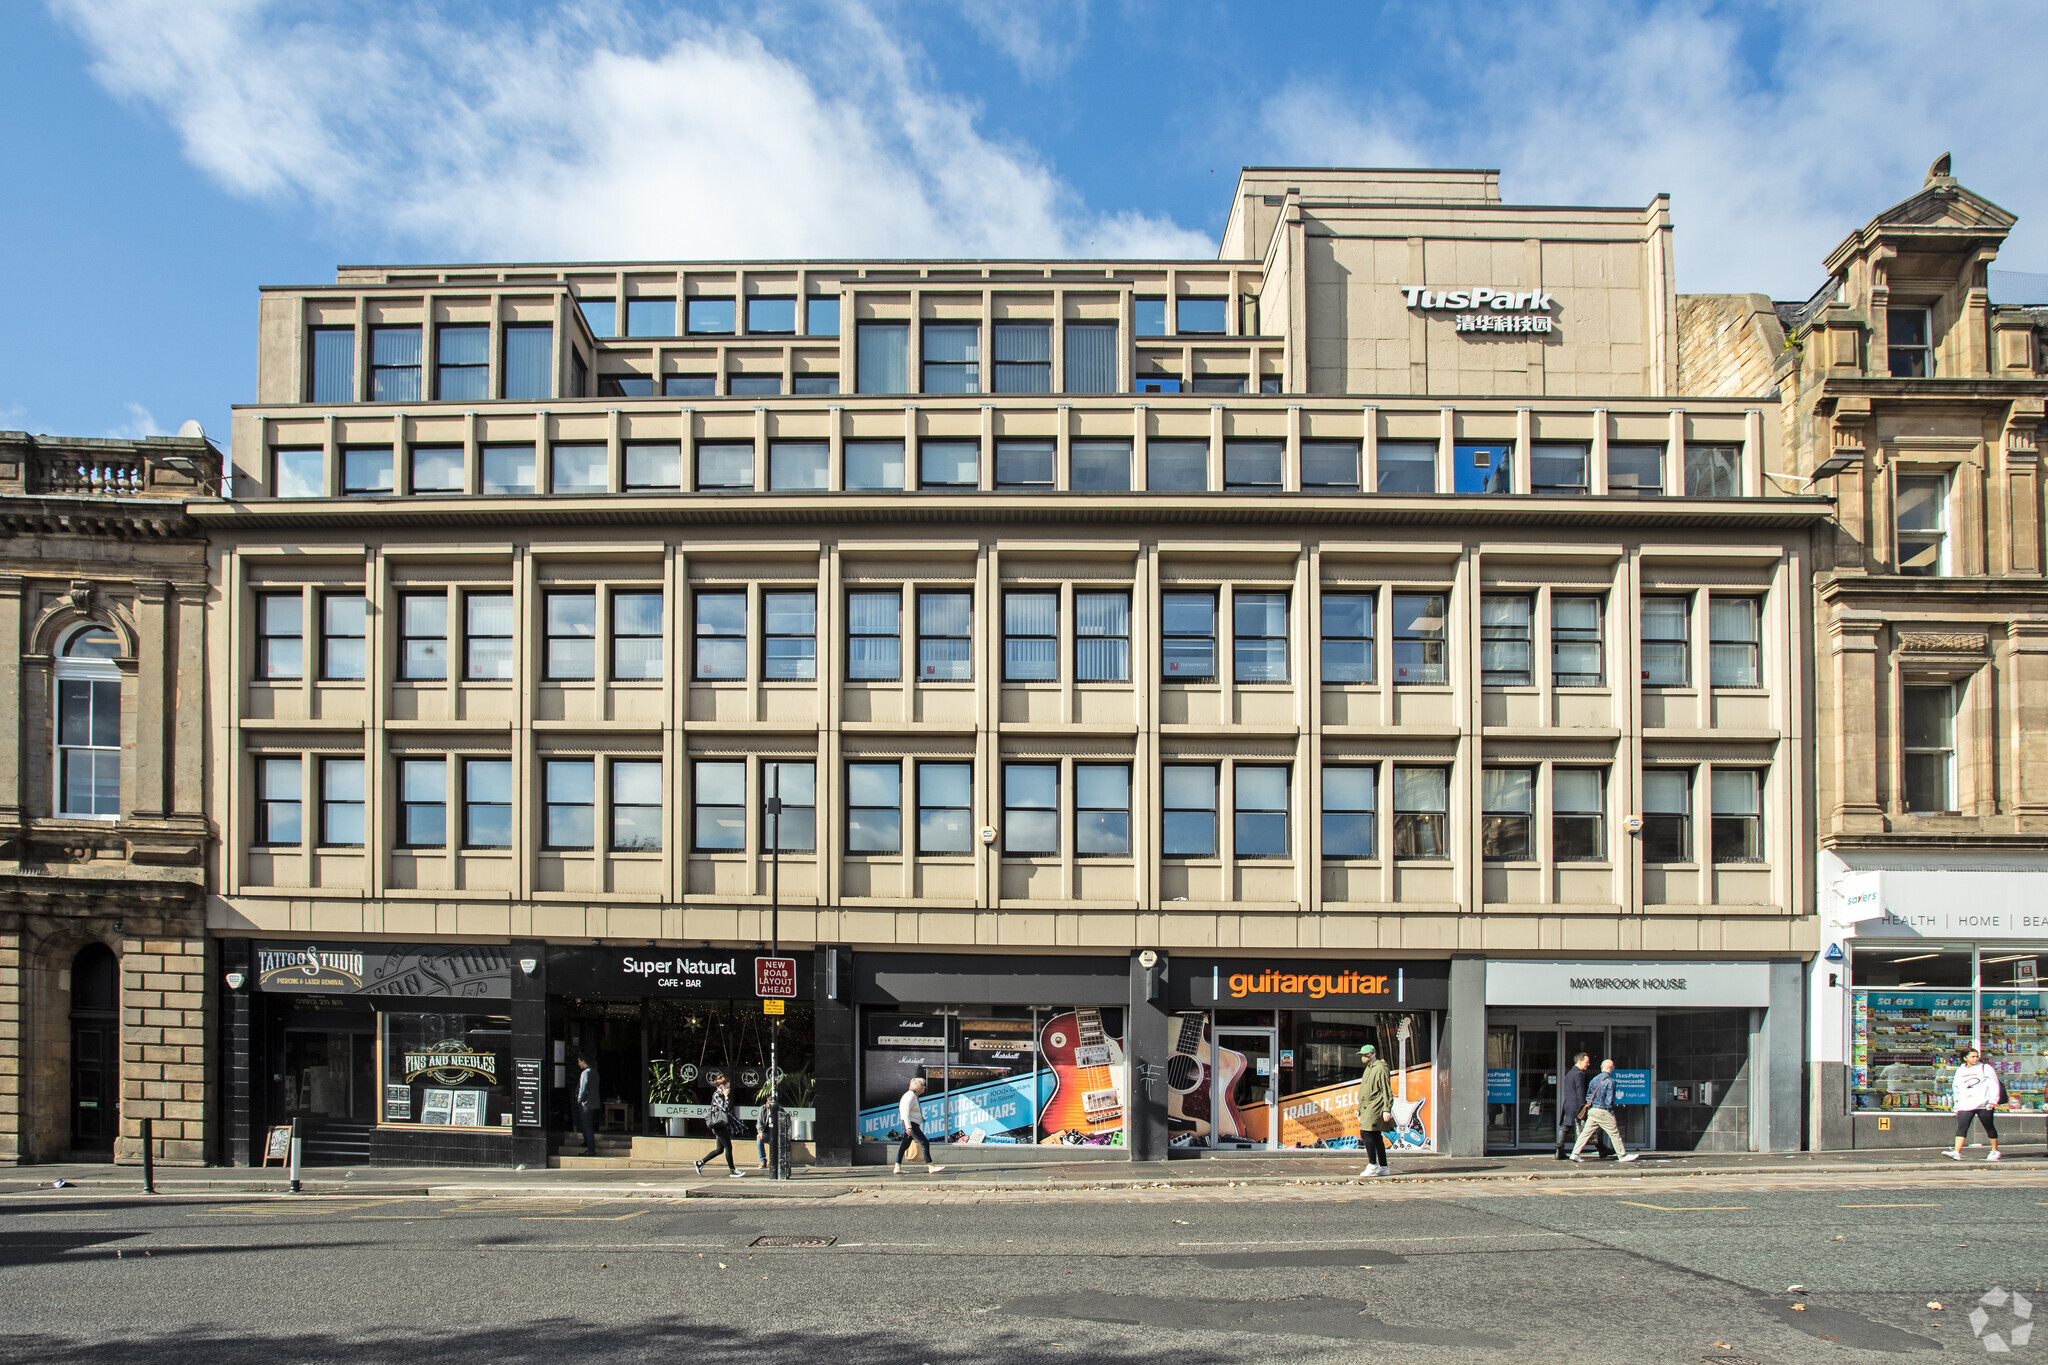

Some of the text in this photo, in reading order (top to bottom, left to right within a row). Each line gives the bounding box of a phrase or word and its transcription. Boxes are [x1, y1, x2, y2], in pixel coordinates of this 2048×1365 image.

[1401, 285, 1552, 311] TusPark
[1456, 314, 1552, 333] 清华科技园
[1847, 890, 1877, 906] savers
[1881, 915, 1936, 926] HEALTH
[1958, 916, 2000, 927] HOME
[623, 957, 737, 978] Super Natural
[765, 961, 786, 969] NEW
[763, 969, 788, 977] ROAD
[658, 978, 702, 988] CAFE BAR
[759, 978, 793, 986] LAYOUT
[1229, 969, 1390, 999] guitarguitar.
[1569, 978, 1688, 991] MAYBROOK HOUSE
[761, 986, 792, 994] AHEAD
[1877, 996, 1914, 1006] savers
[1935, 997, 1971, 1007] savers
[1992, 996, 2029, 1007] savers
[899, 1020, 924, 1028] Marshall
[899, 1056, 926, 1064] Marshall
[992, 1051, 1020, 1060] Marshall
[405, 1055, 496, 1074] PINS AND NEEDLES
[1010, 1083, 1031, 1094] Guitars
[940, 1093, 988, 1116] LARGEST
[1283, 1101, 1319, 1122] TRADE
[1320, 1098, 1333, 1113] IT.
[666, 1107, 688, 1115] CAFE
[954, 1114, 967, 1129] OF
[969, 1102, 1017, 1125] GUITARS
[1306, 1115, 1323, 1124] value
[1880, 1118, 1889, 1129] H
